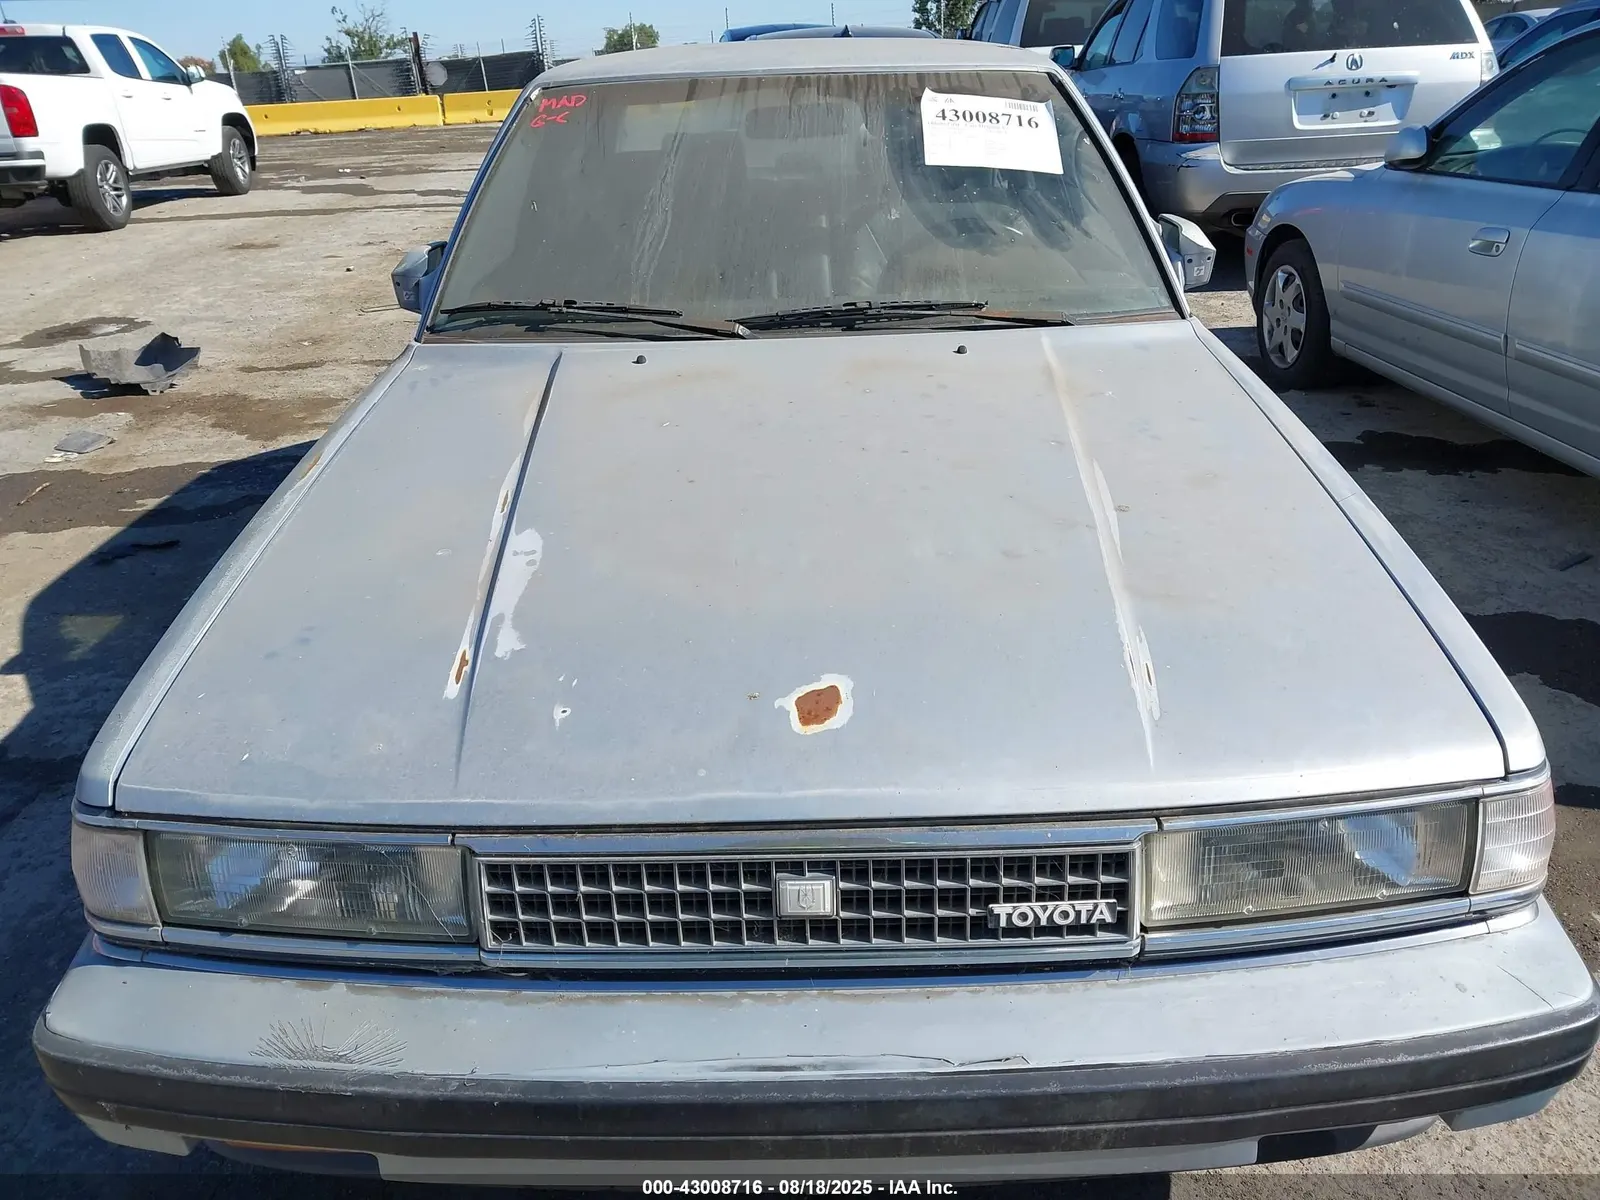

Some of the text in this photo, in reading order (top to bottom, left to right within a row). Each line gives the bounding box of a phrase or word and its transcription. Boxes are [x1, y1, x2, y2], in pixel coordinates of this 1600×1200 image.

[1449, 51, 1475, 60] MDX
[1323, 77, 1389, 86] ACURA
[539, 94, 587, 112] MAD
[935, 107, 1040, 129] 43008716
[992, 902, 1112, 928] TOYOTA
